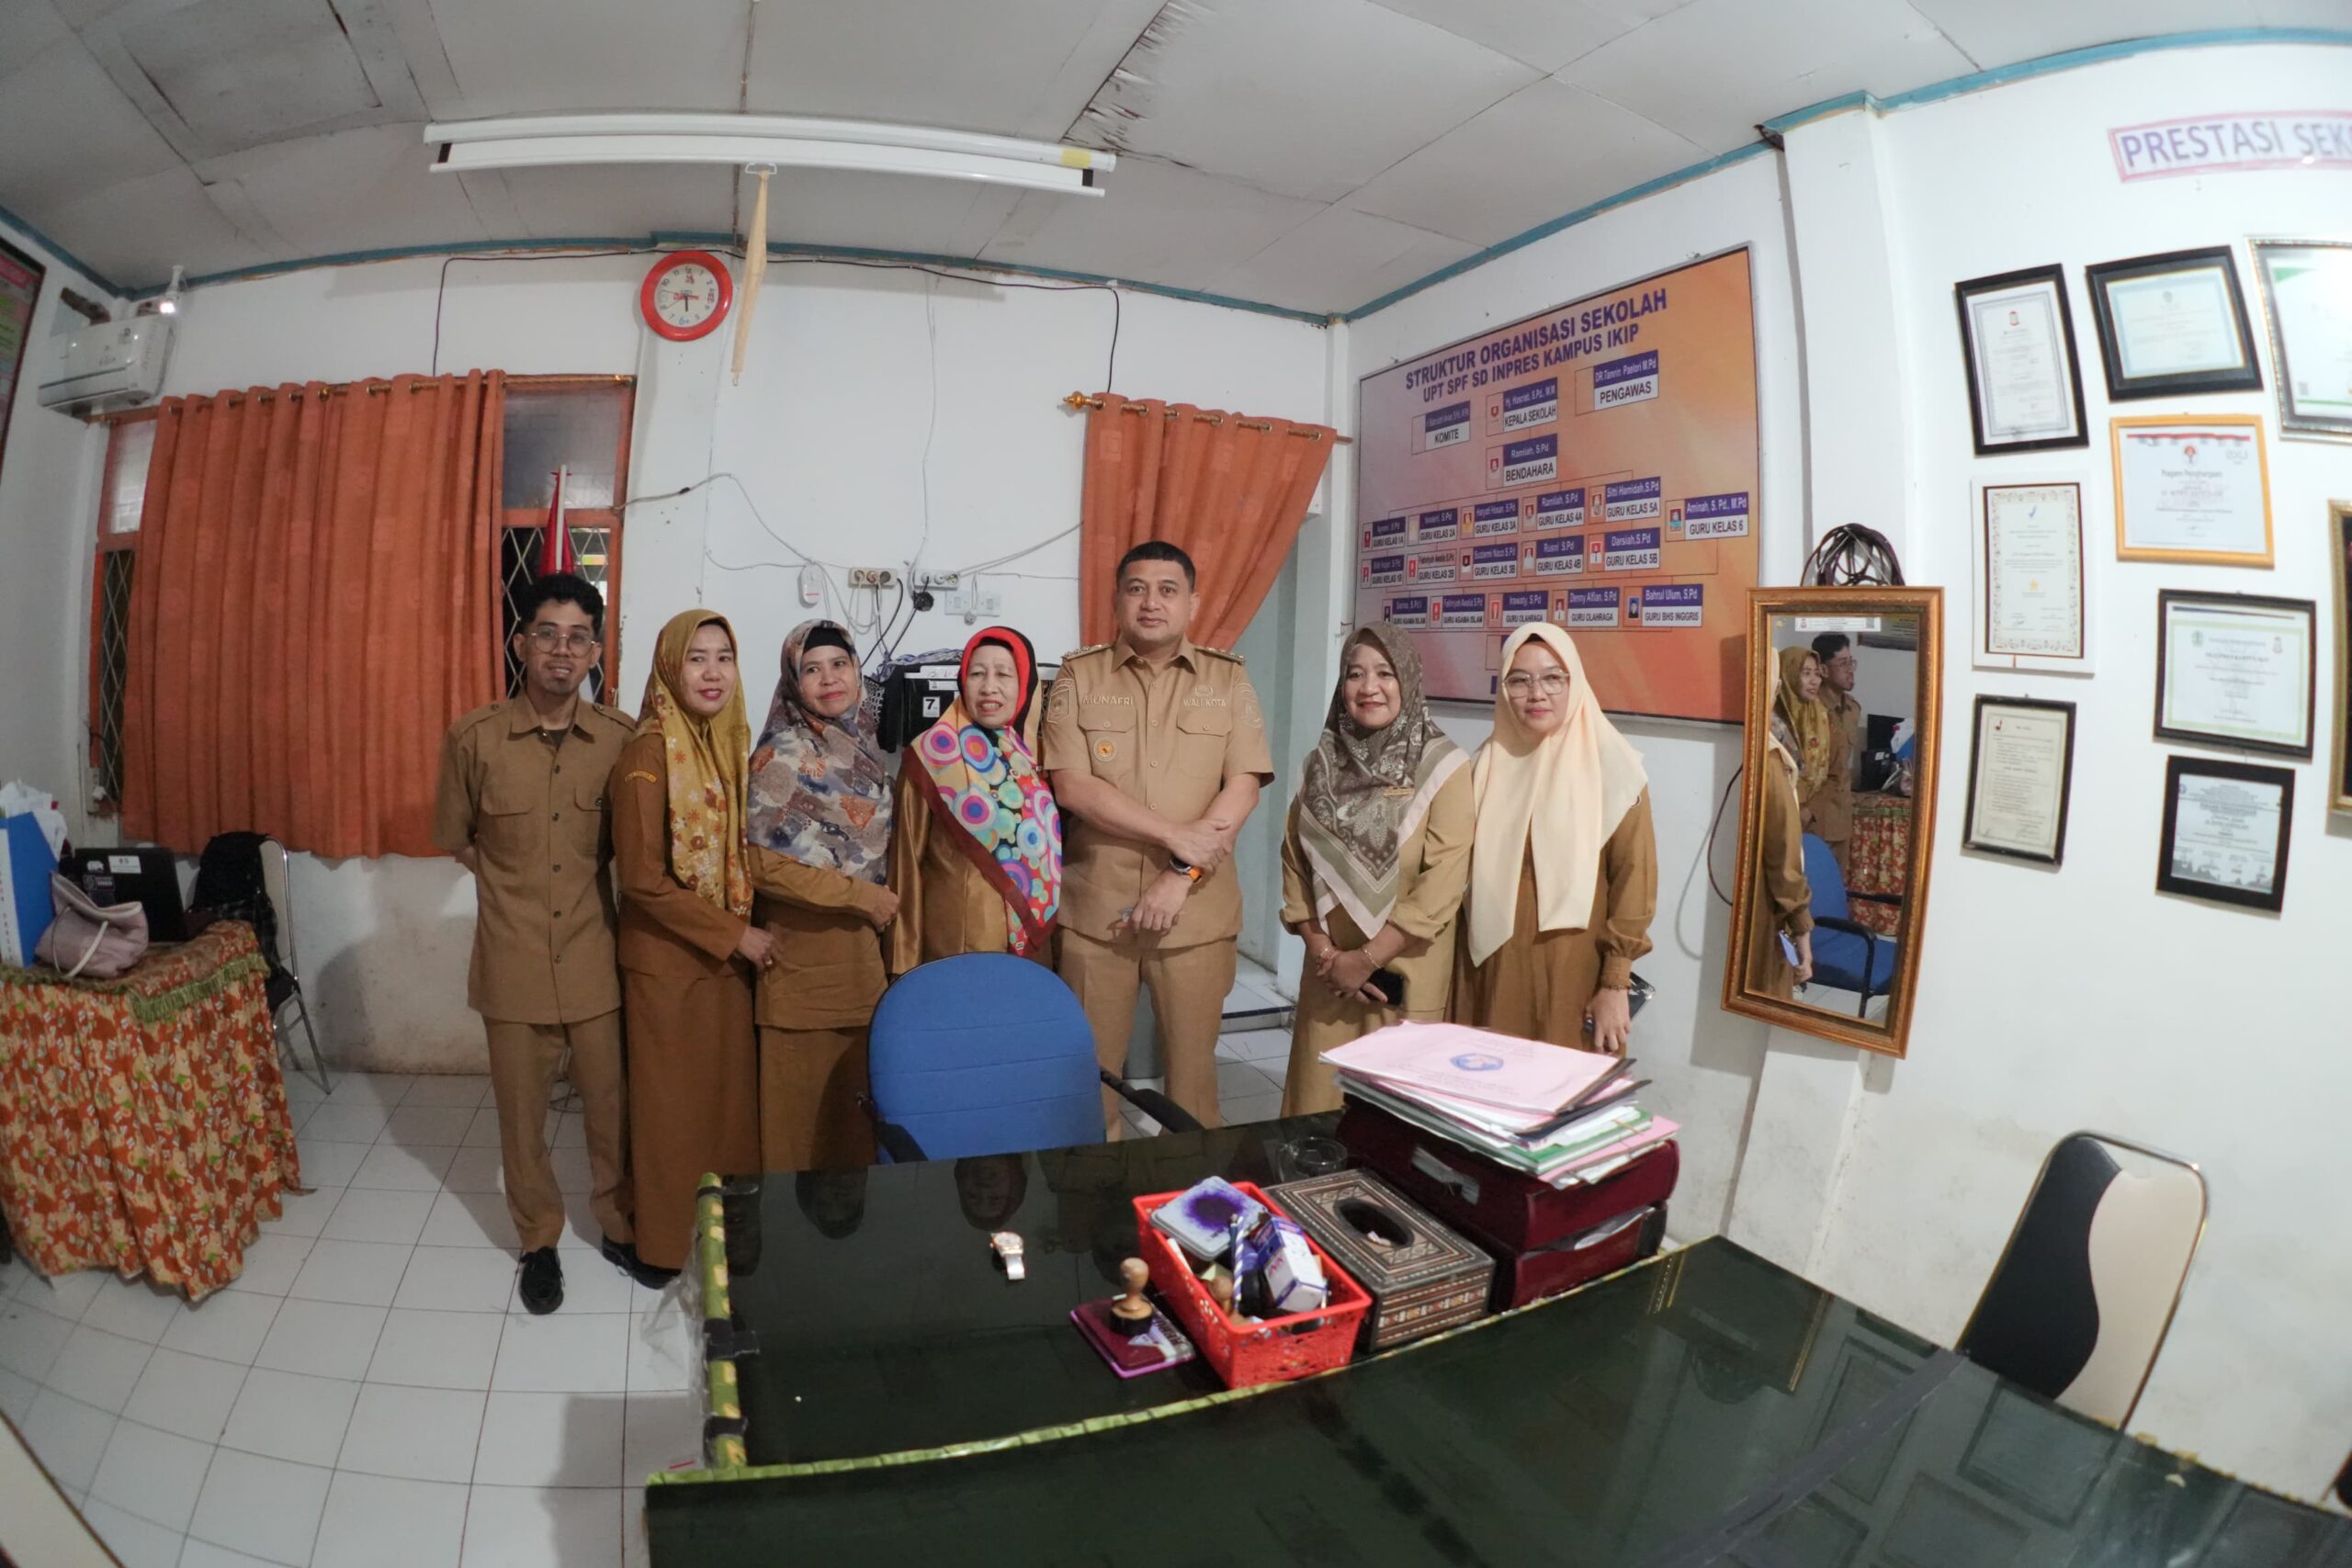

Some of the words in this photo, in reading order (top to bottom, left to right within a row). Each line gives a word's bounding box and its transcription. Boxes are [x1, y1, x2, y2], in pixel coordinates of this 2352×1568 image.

[2120, 120, 2285, 167] PRESTASI
[2292, 122, 2352, 156] SEK
[1406, 350, 1476, 389] STRUKTUR
[1480, 317, 1576, 366] ORGANISASI
[1581, 288, 1668, 333] SEKOLAH
[1424, 382, 1443, 403] UPT
[1447, 374, 1468, 395] SPF
[1472, 368, 1488, 388] SD
[1492, 353, 1540, 383] INPRES
[1544, 333, 1602, 368] KAMPUS
[1607, 322, 1640, 348] IKIP
[1600, 381, 1651, 405] PENGAWAS
[1504, 412, 1527, 427] KEPALA
[1528, 404, 1556, 422] SEKOLAH
[1435, 428, 1459, 444] KOMITE
[1536, 442, 1549, 454] S.Pd
[1505, 462, 1554, 482] BENDAHARA
[1565, 493, 1578, 503] S.Pd
[1607, 505, 1625, 518] GURU
[1626, 503, 1648, 515] KELAS
[1649, 502, 1658, 513] 5A
[1538, 515, 1554, 526] GURU
[1555, 513, 1574, 524] KELAS
[1575, 512, 1583, 521] 4A
[1476, 525, 1490, 533] GURU
[1491, 521, 1508, 531] KELAS
[1510, 521, 1516, 530] 3A
[1690, 523, 1711, 535] GURU
[1712, 520, 1737, 533] KELAS
[1738, 520, 1743, 531] 6
[1420, 532, 1432, 541] GURU
[1434, 529, 1449, 539] KELAS
[1449, 528, 1455, 537] 2A
[1373, 538, 1384, 547] GURU
[1384, 536, 1398, 546] KELAS
[1561, 541, 1574, 551] S.Pd
[1538, 561, 1553, 572] GURU
[1554, 559, 1573, 570] KELAS
[1607, 555, 1624, 567] GURU
[1626, 554, 1647, 565] KELAS
[1649, 553, 1657, 564] 5B
[1419, 572, 1431, 581] GURU
[1432, 570, 1447, 579] KELAS
[1475, 567, 1489, 576] GURU
[1490, 565, 1507, 575] KELAS
[1372, 576, 1383, 584] GURU
[1383, 575, 1396, 583] KELAS
[1529, 595, 1542, 605] S.Pd
[1604, 591, 1617, 602] S.Pd
[1645, 590, 1665, 600] Bahrul
[1683, 589, 1698, 600] S.Pd
[1519, 614, 1543, 622] OLAHRAGA
[1572, 614, 1585, 622] GURU
[1586, 613, 1613, 621] OLAHRAGA
[1645, 612, 1661, 621] GURU
[1662, 612, 1674, 621] BHS
[1676, 611, 1699, 621] INGGRIS
[925, 699, 935, 710] 7
[1082, 695, 1133, 706] MUNAFRI
[1183, 698, 1203, 707] WALI
[1205, 698, 1227, 707] KOTA
